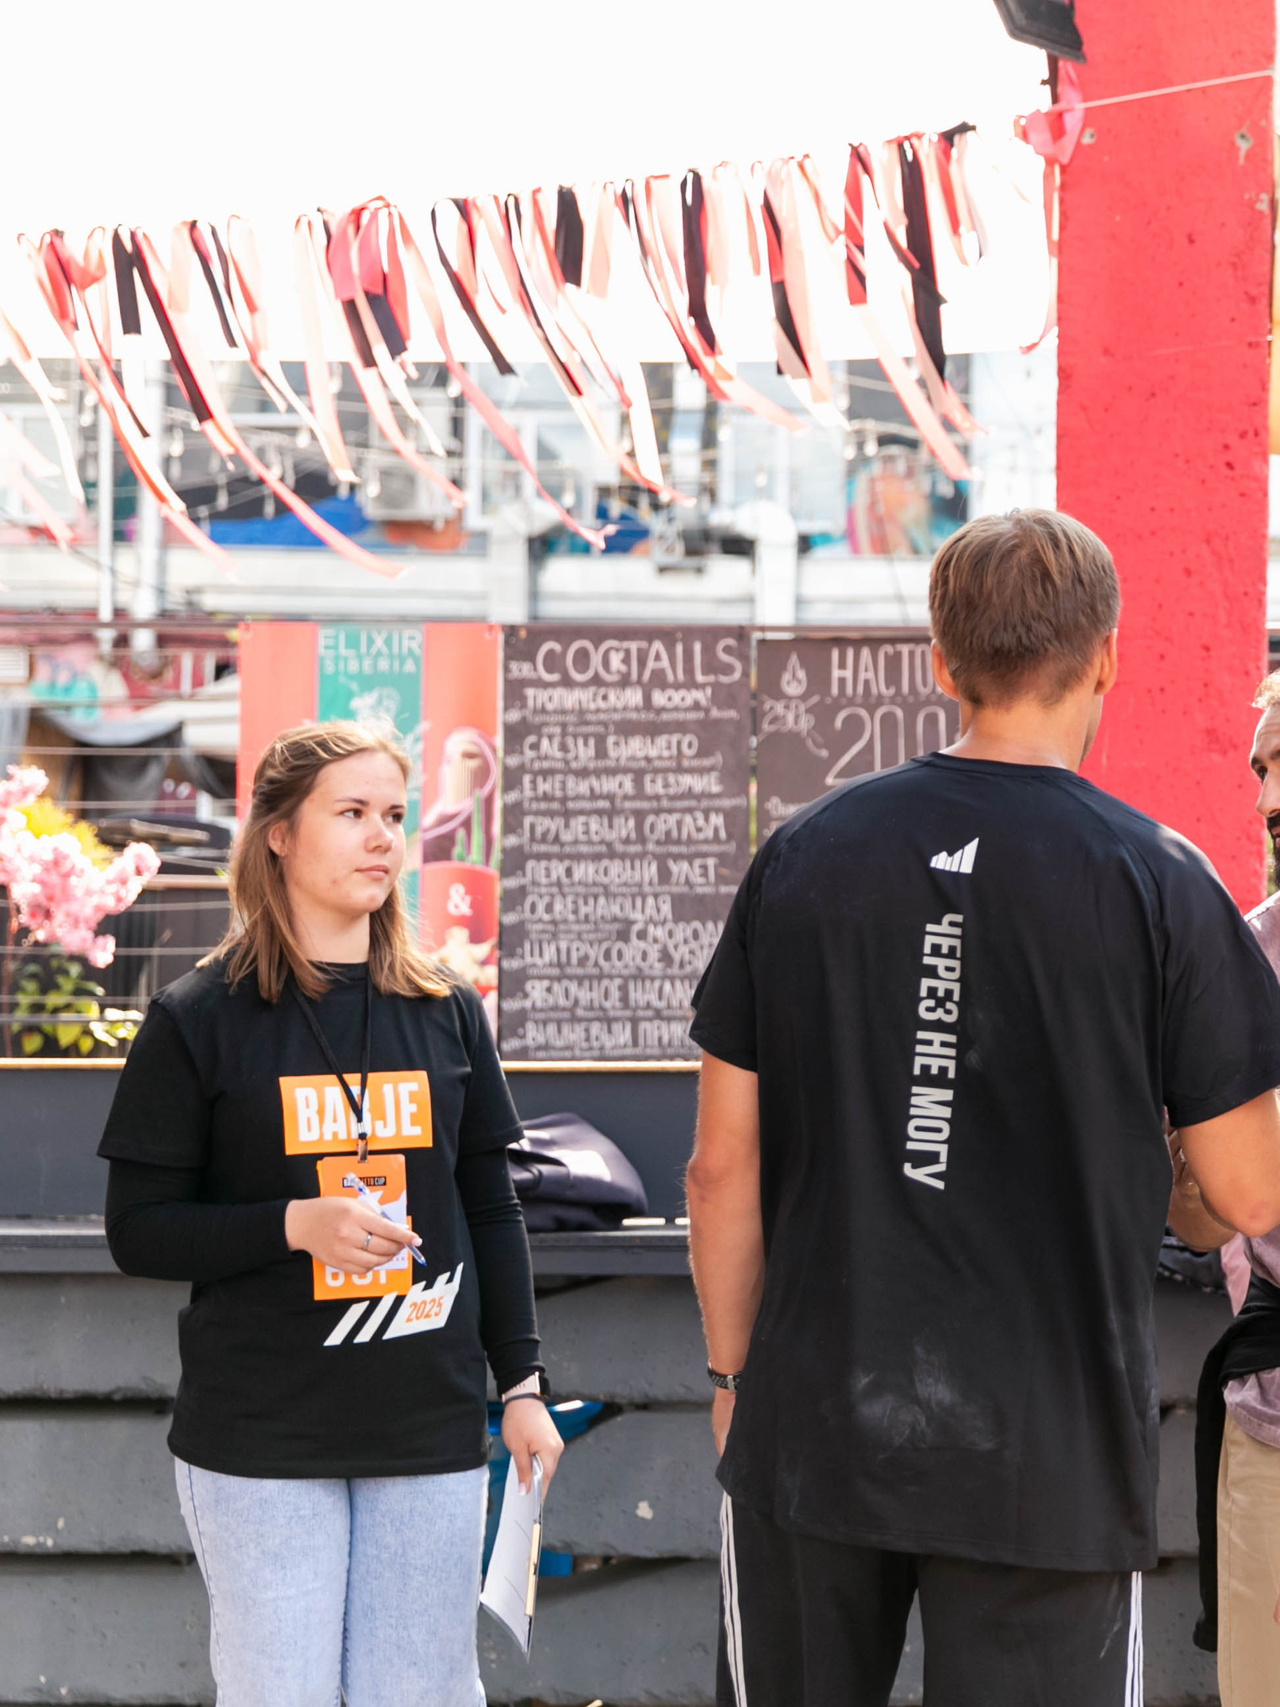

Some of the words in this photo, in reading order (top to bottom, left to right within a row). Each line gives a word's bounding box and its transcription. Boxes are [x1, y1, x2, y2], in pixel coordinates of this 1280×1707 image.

[318, 629, 423, 656] ELIXIR
[323, 656, 417, 675] SIBERIA
[830, 643, 943, 698] НАСТО
[525, 855, 659, 887] ПЕРСИКОВЫЙ
[917, 912, 964, 1024] ЧЕРЕЗ
[912, 1030, 958, 1080] НЕ
[903, 1086, 955, 1191] МОГУ
[405, 1297, 444, 1324] 2025
